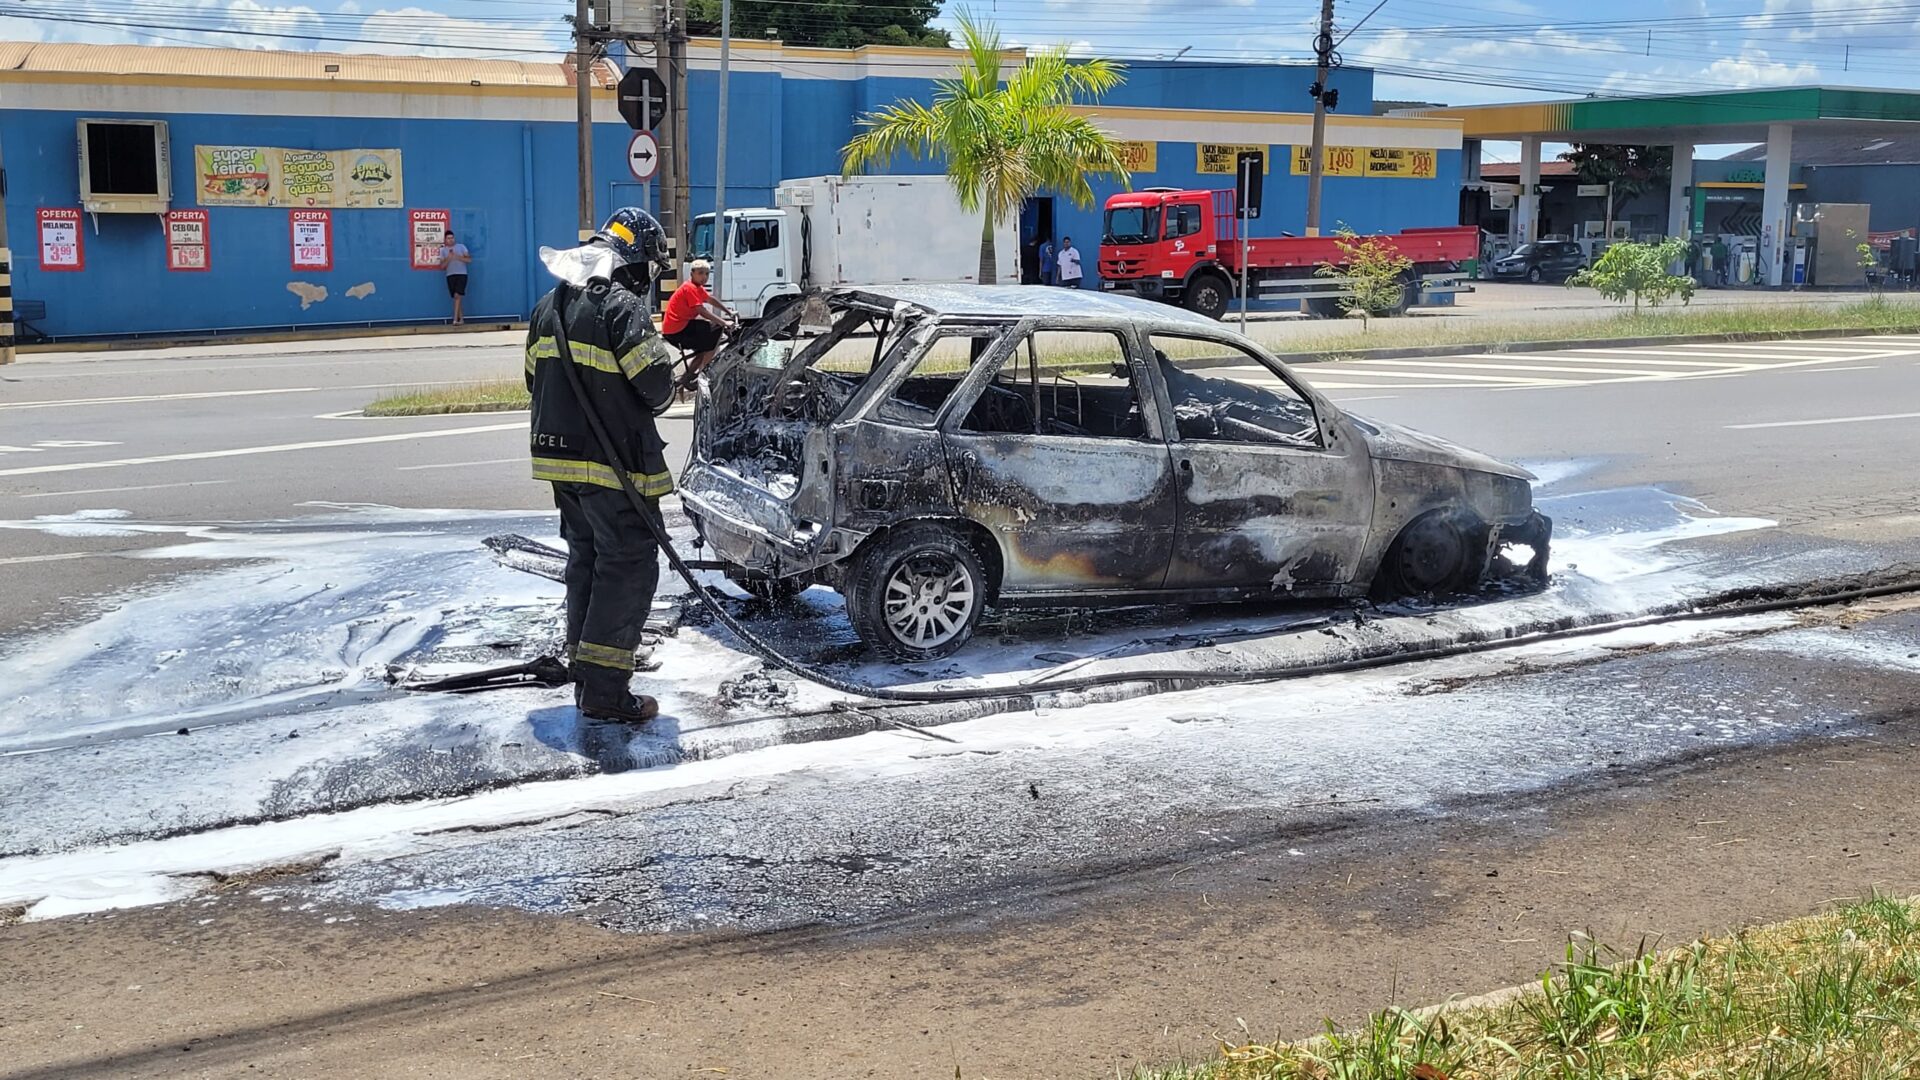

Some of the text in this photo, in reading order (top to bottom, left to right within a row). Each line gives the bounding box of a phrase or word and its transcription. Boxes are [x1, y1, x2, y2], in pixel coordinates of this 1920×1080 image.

[212, 149, 257, 163] super
[211, 161, 256, 175] feirão
[283, 160, 335, 175] segunda
[42, 210, 79, 218] OFERTA
[170, 211, 206, 220] OFERTA
[293, 211, 329, 220] OFERTA
[413, 211, 447, 220] OFERTA
[43, 222, 74, 230] MELANCIA
